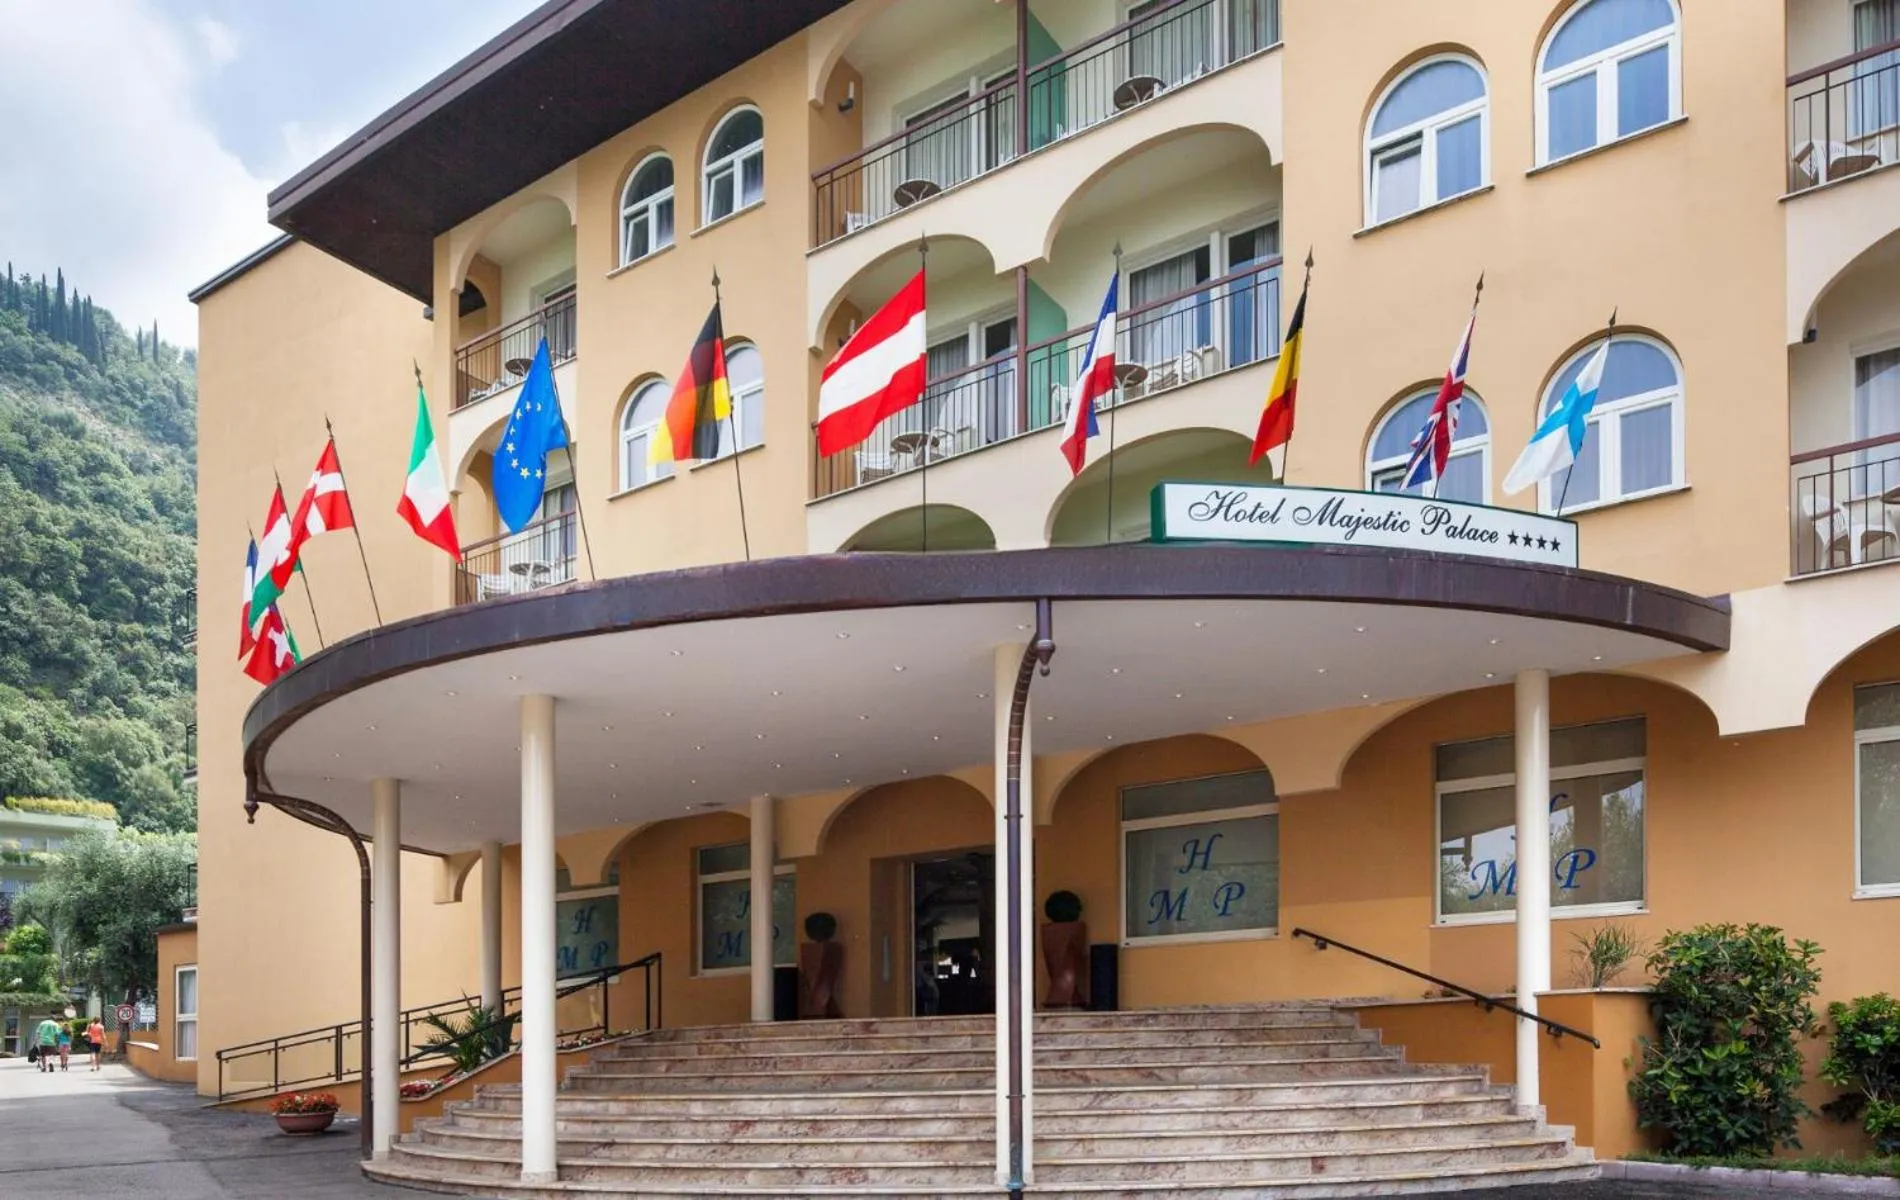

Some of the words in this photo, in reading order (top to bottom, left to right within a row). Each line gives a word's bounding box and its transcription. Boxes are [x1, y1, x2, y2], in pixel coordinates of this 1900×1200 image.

[1188, 489, 1286, 525] Hotel
[1292, 496, 1410, 541] Majestic
[1420, 504, 1499, 543] Palace
[1178, 833, 1224, 875] H
[1555, 848, 1596, 889] P
[1147, 887, 1190, 925] M
[1213, 881, 1246, 917] P
